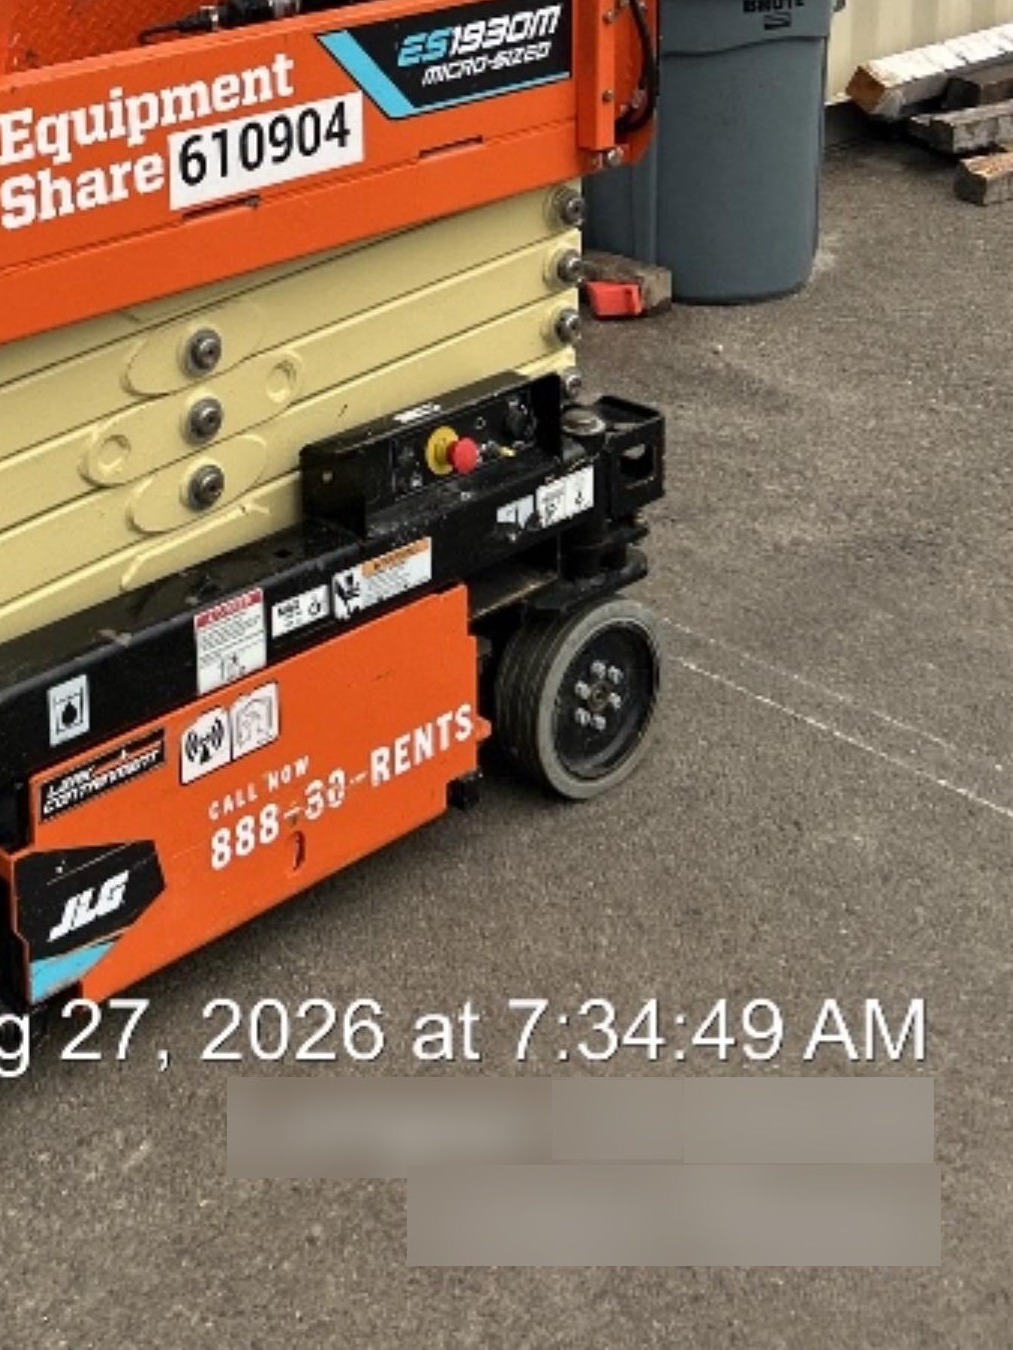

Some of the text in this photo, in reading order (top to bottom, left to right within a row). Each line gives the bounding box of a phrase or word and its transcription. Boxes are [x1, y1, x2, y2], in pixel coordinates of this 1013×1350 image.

[397, 3, 563, 68] ES1930M
[421, 40, 552, 87] MICRO-SIZED
[178, 101, 351, 187] 610904
[207, 754, 311, 822] CALL NOW
[47, 868, 130, 944] JLG
